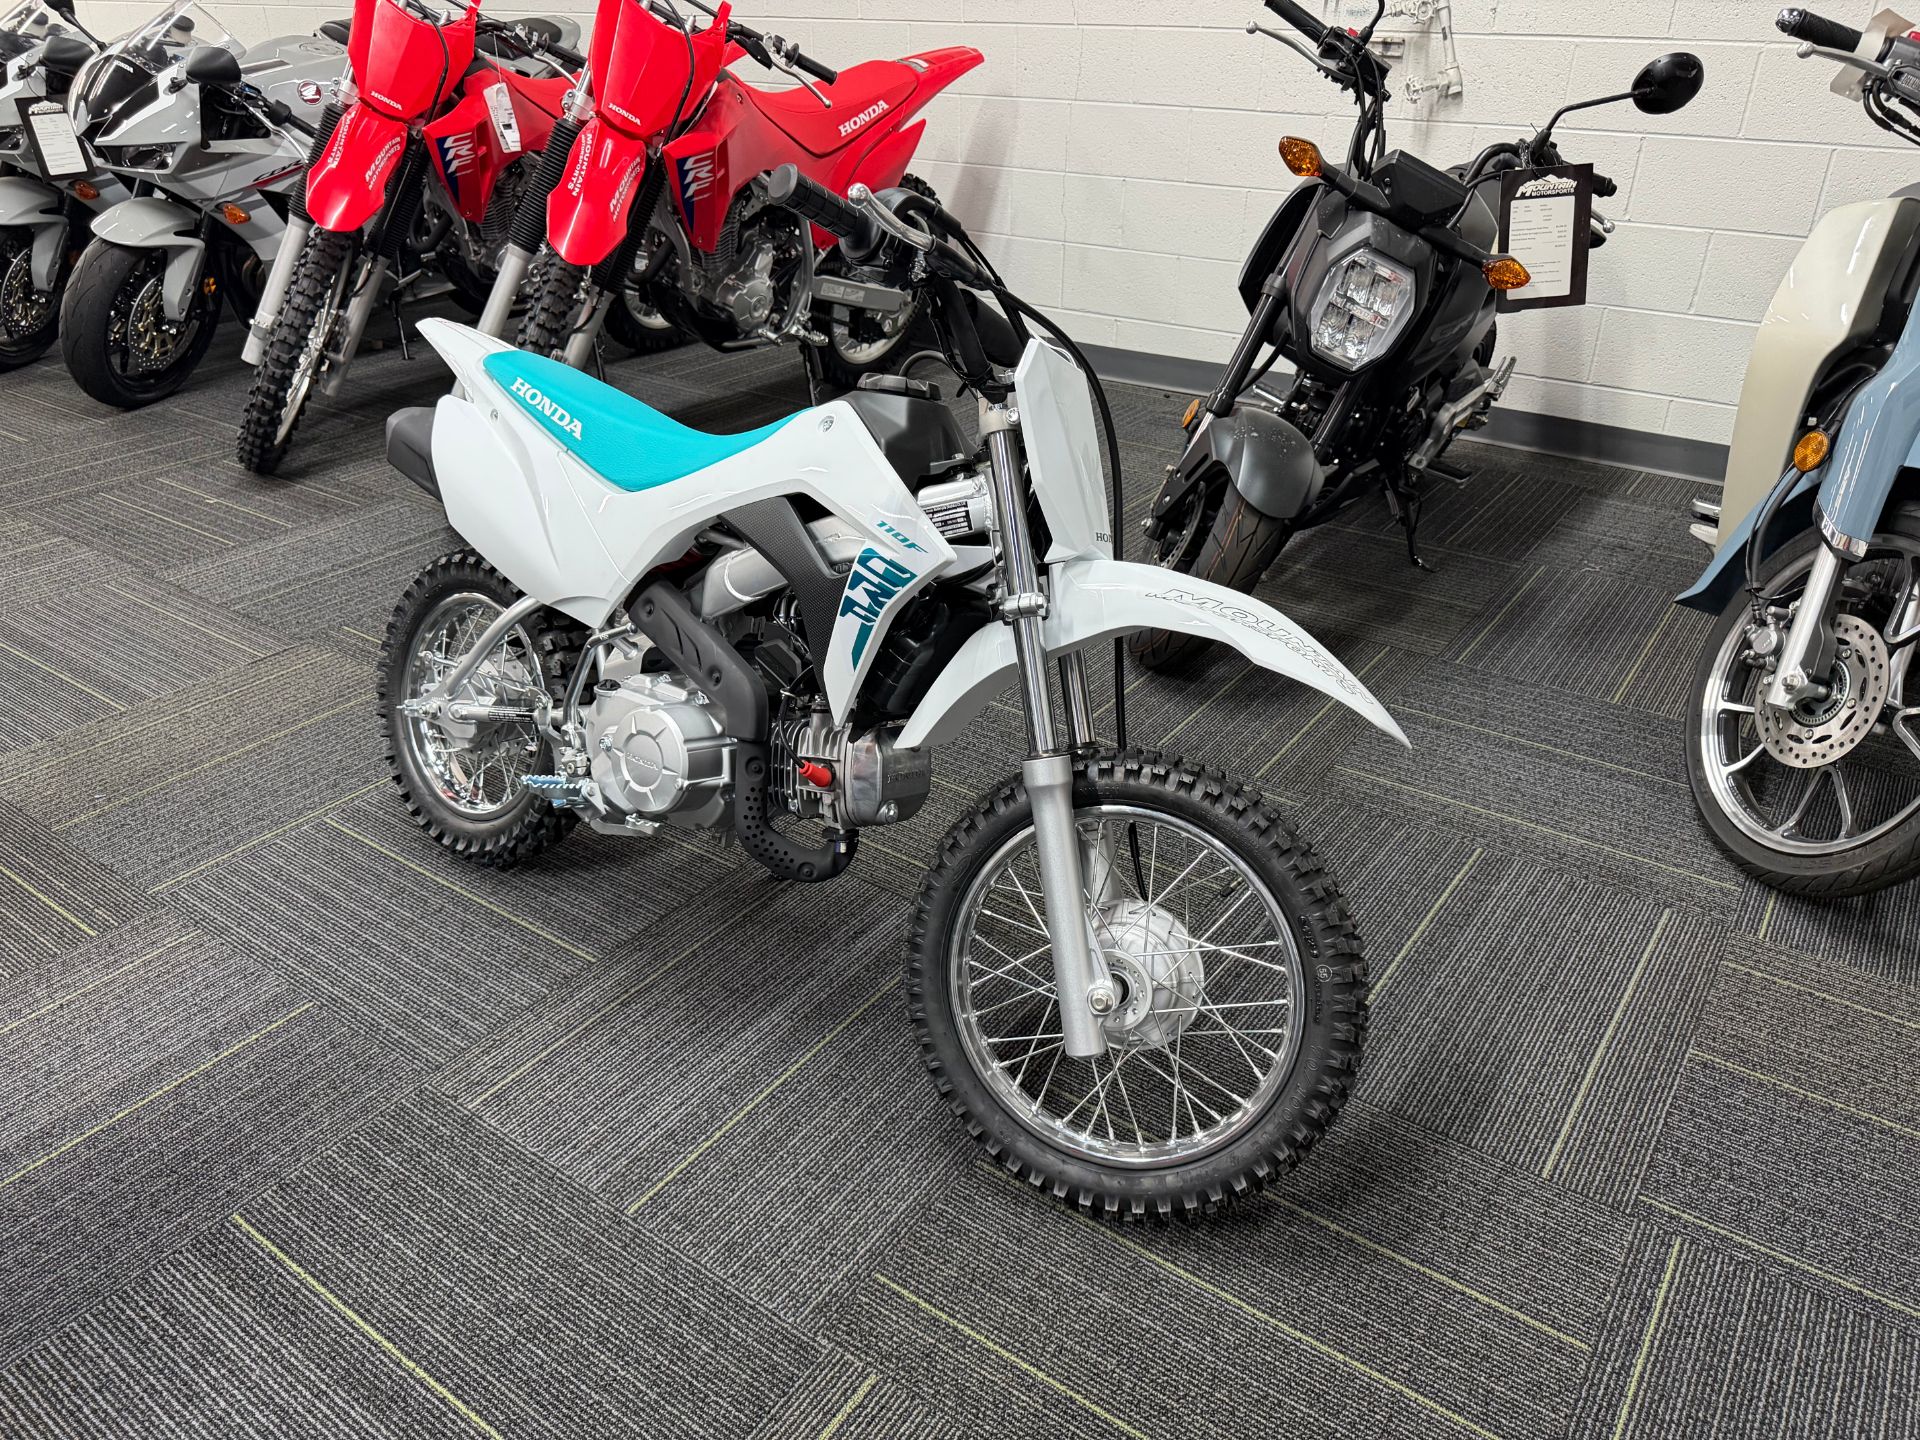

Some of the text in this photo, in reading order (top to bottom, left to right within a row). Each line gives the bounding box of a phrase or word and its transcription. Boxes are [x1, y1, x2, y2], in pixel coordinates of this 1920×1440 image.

[370, 90, 403, 111] HONDA
[608, 102, 642, 126] HONDA
[838, 99, 890, 137] HONDA
[364, 136, 401, 183] MOUNTAIN
[443, 131, 477, 174] CRF
[572, 133, 593, 197] MOUNTAIN
[609, 156, 641, 213] MOUNTAIN
[683, 151, 715, 199] CRF
[1531, 188, 1575, 197] MOTORSPORTS
[510, 376, 583, 441] HONDA
[876, 520, 929, 554] 110F
